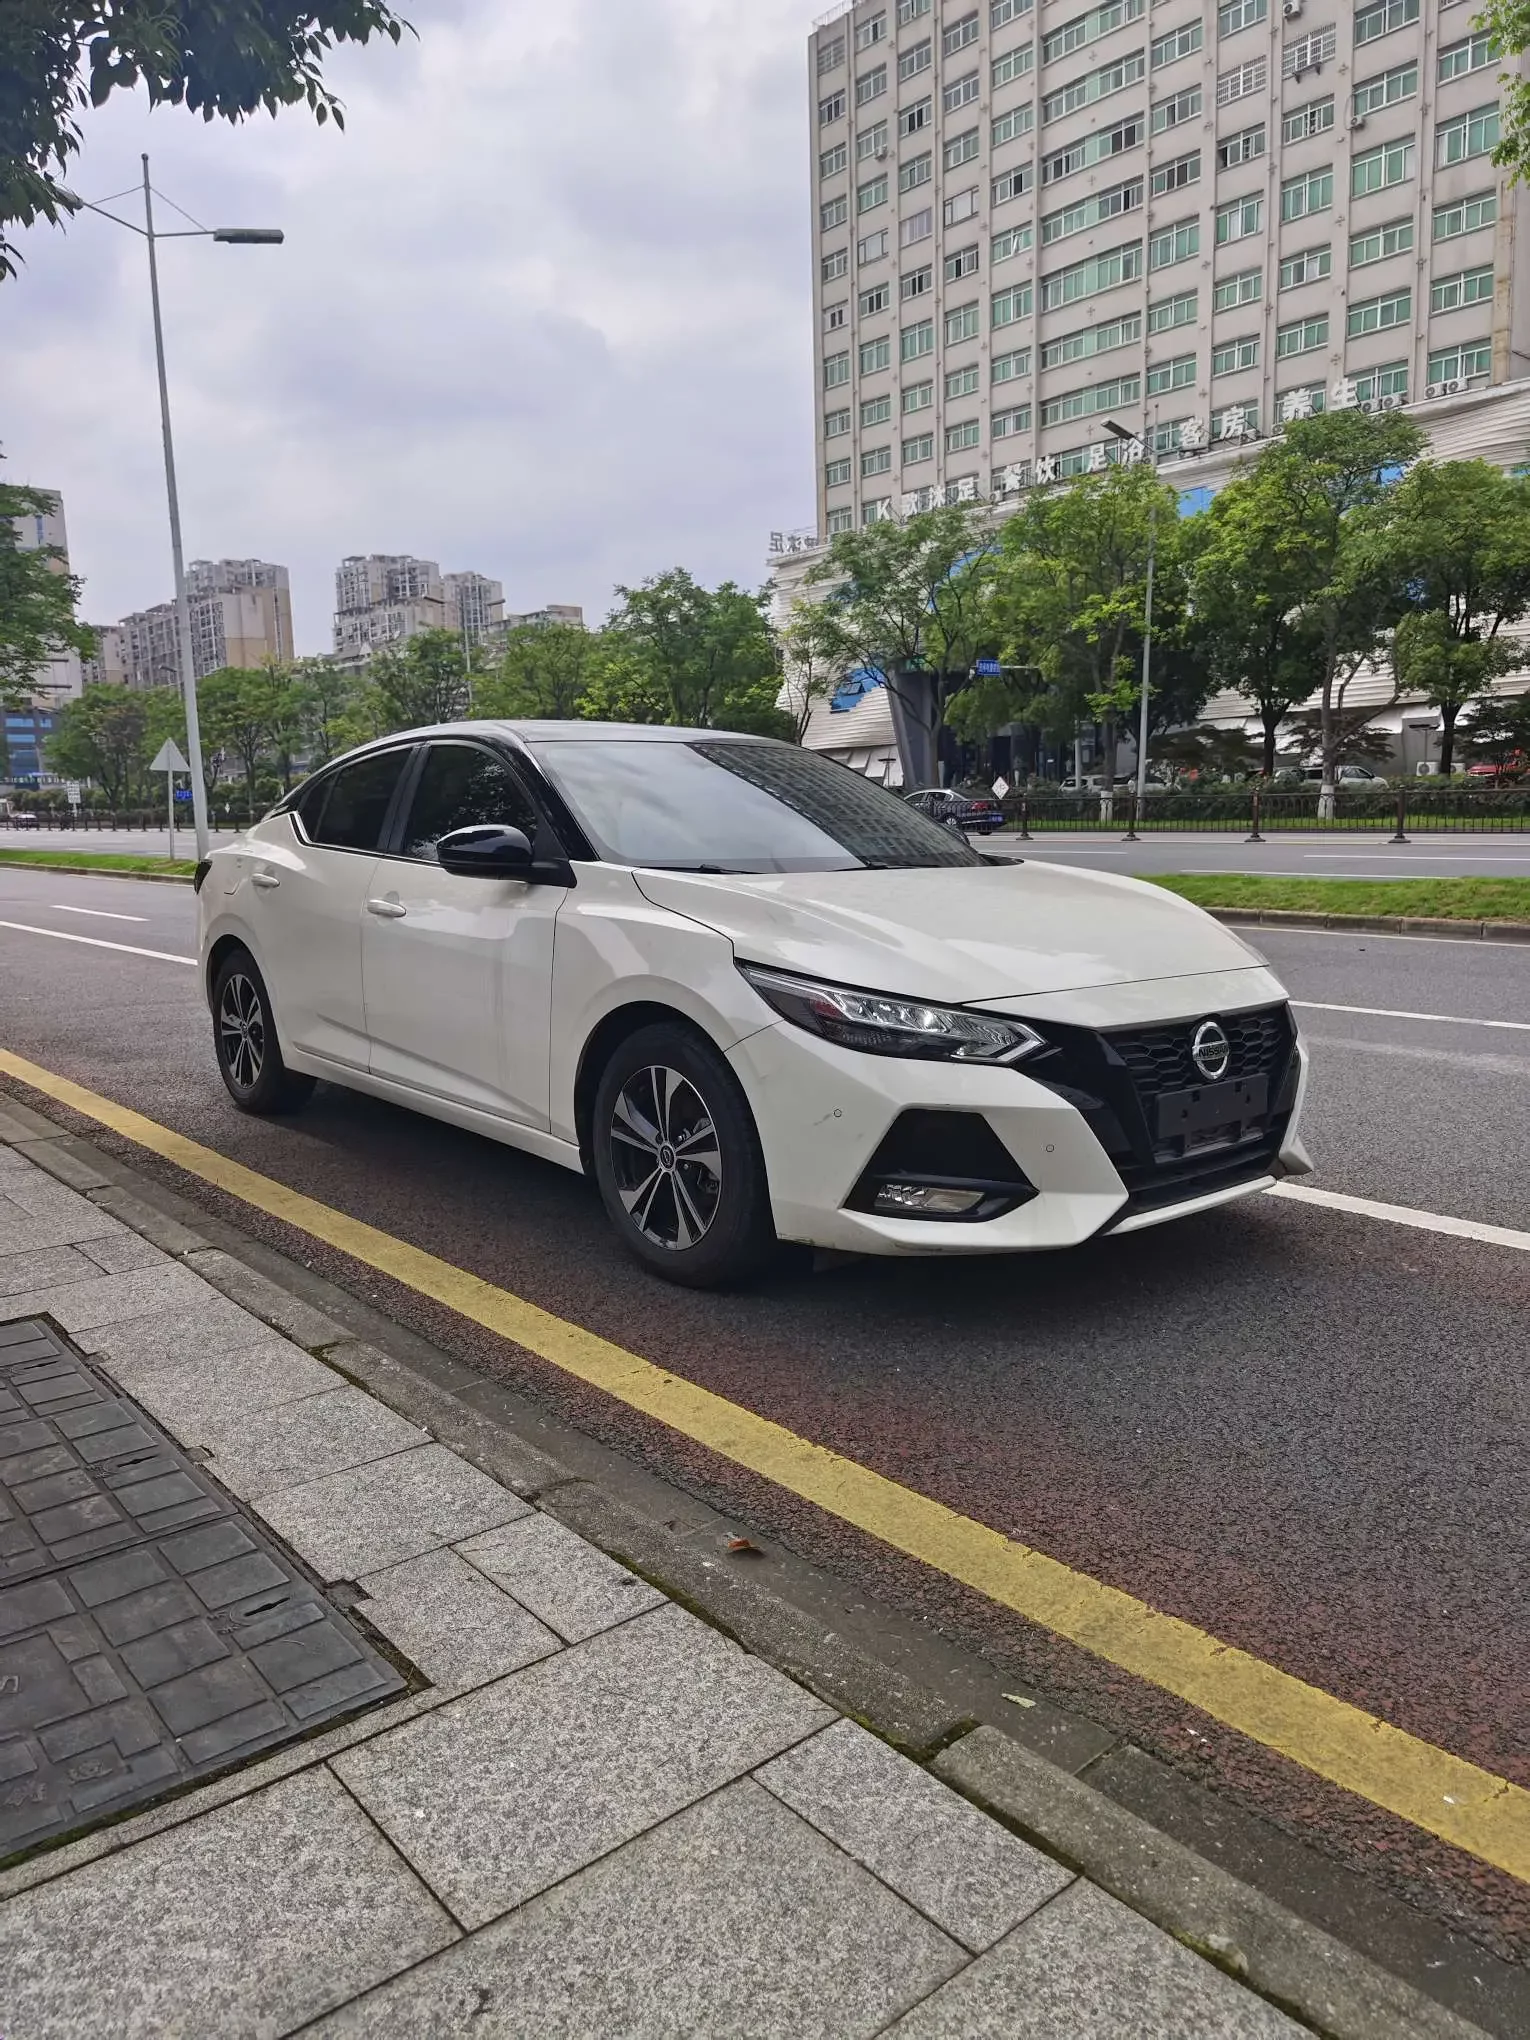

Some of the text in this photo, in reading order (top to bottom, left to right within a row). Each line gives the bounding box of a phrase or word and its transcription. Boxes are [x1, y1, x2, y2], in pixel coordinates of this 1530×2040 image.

[1001, 456, 1056, 491] 餐饮
[1086, 432, 1146, 473] 足浴
[1180, 406, 1245, 450] 客房
[1282, 378, 1358, 421] 养生
[1200, 1045, 1227, 1056] NISSAN
